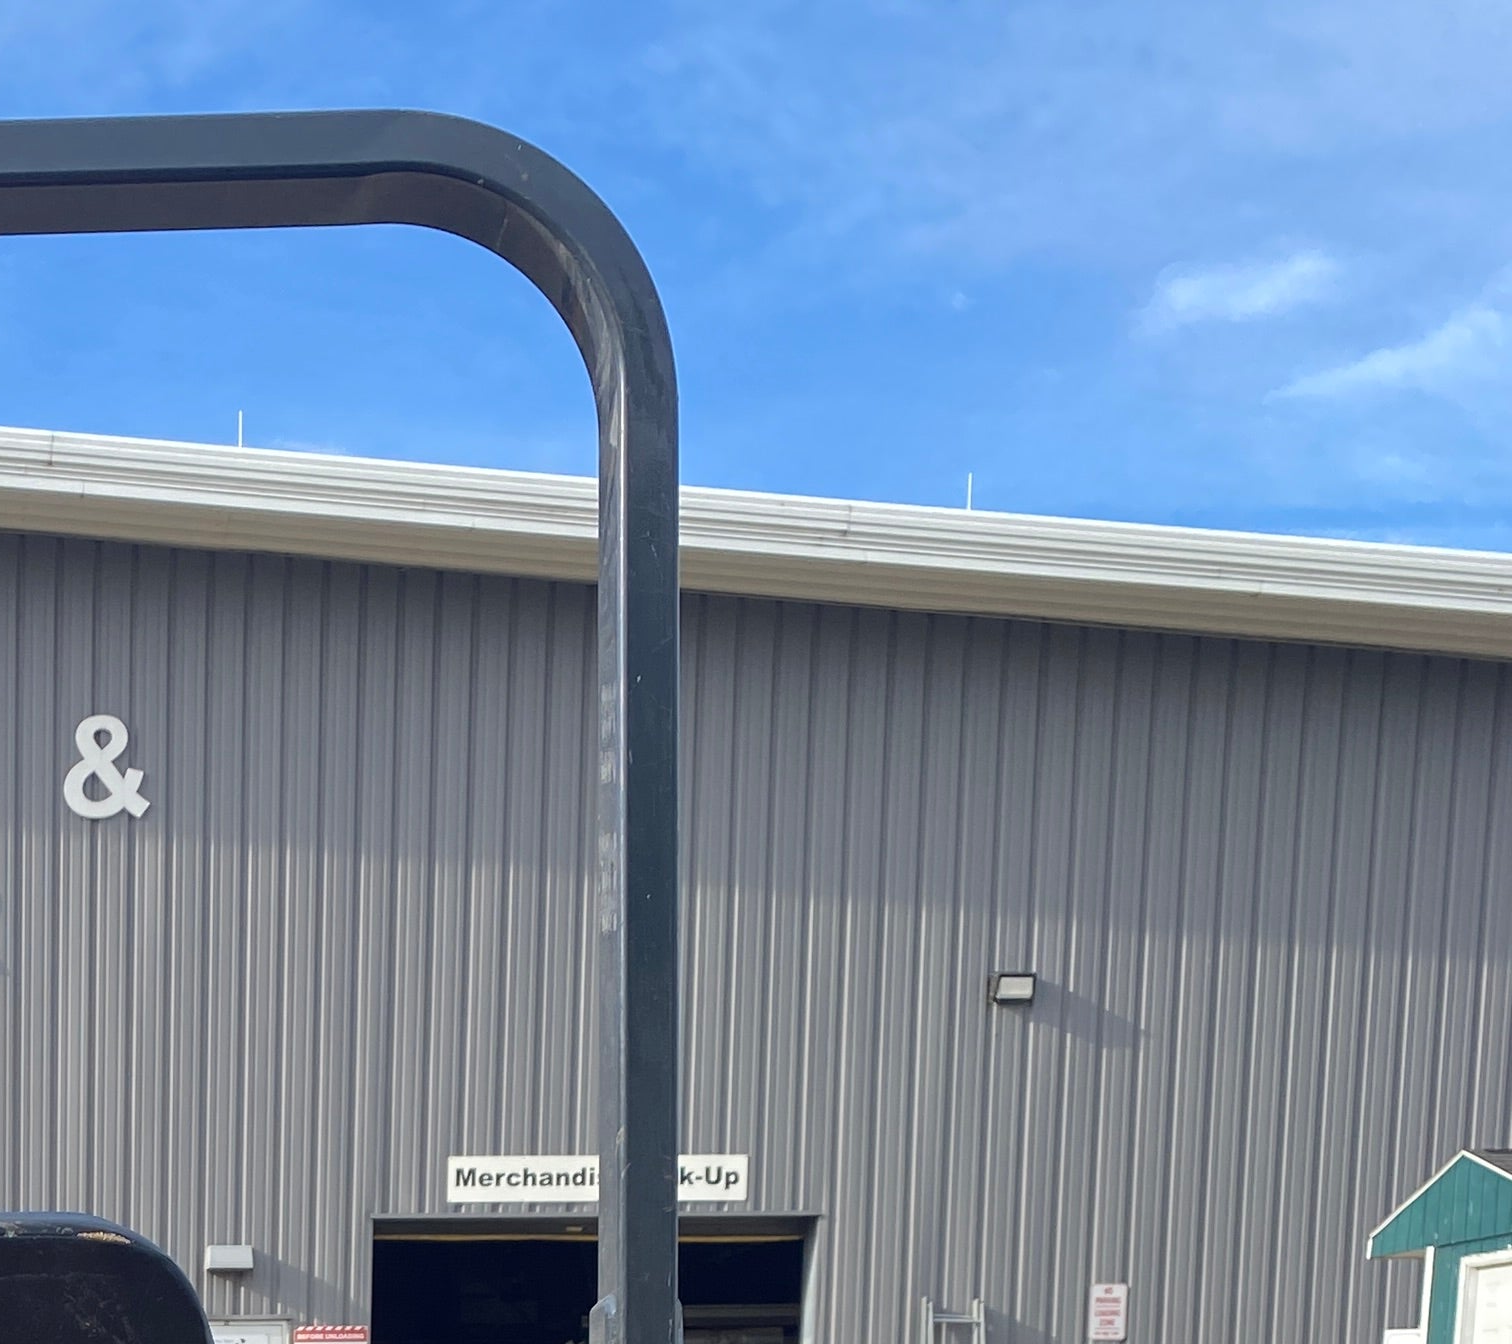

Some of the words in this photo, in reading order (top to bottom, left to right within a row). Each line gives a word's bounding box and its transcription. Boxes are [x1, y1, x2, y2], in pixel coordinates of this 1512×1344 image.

[62, 714, 152, 819] &
[455, 1167, 599, 1188] Merchandi
[679, 1166, 740, 1190] k-Up
